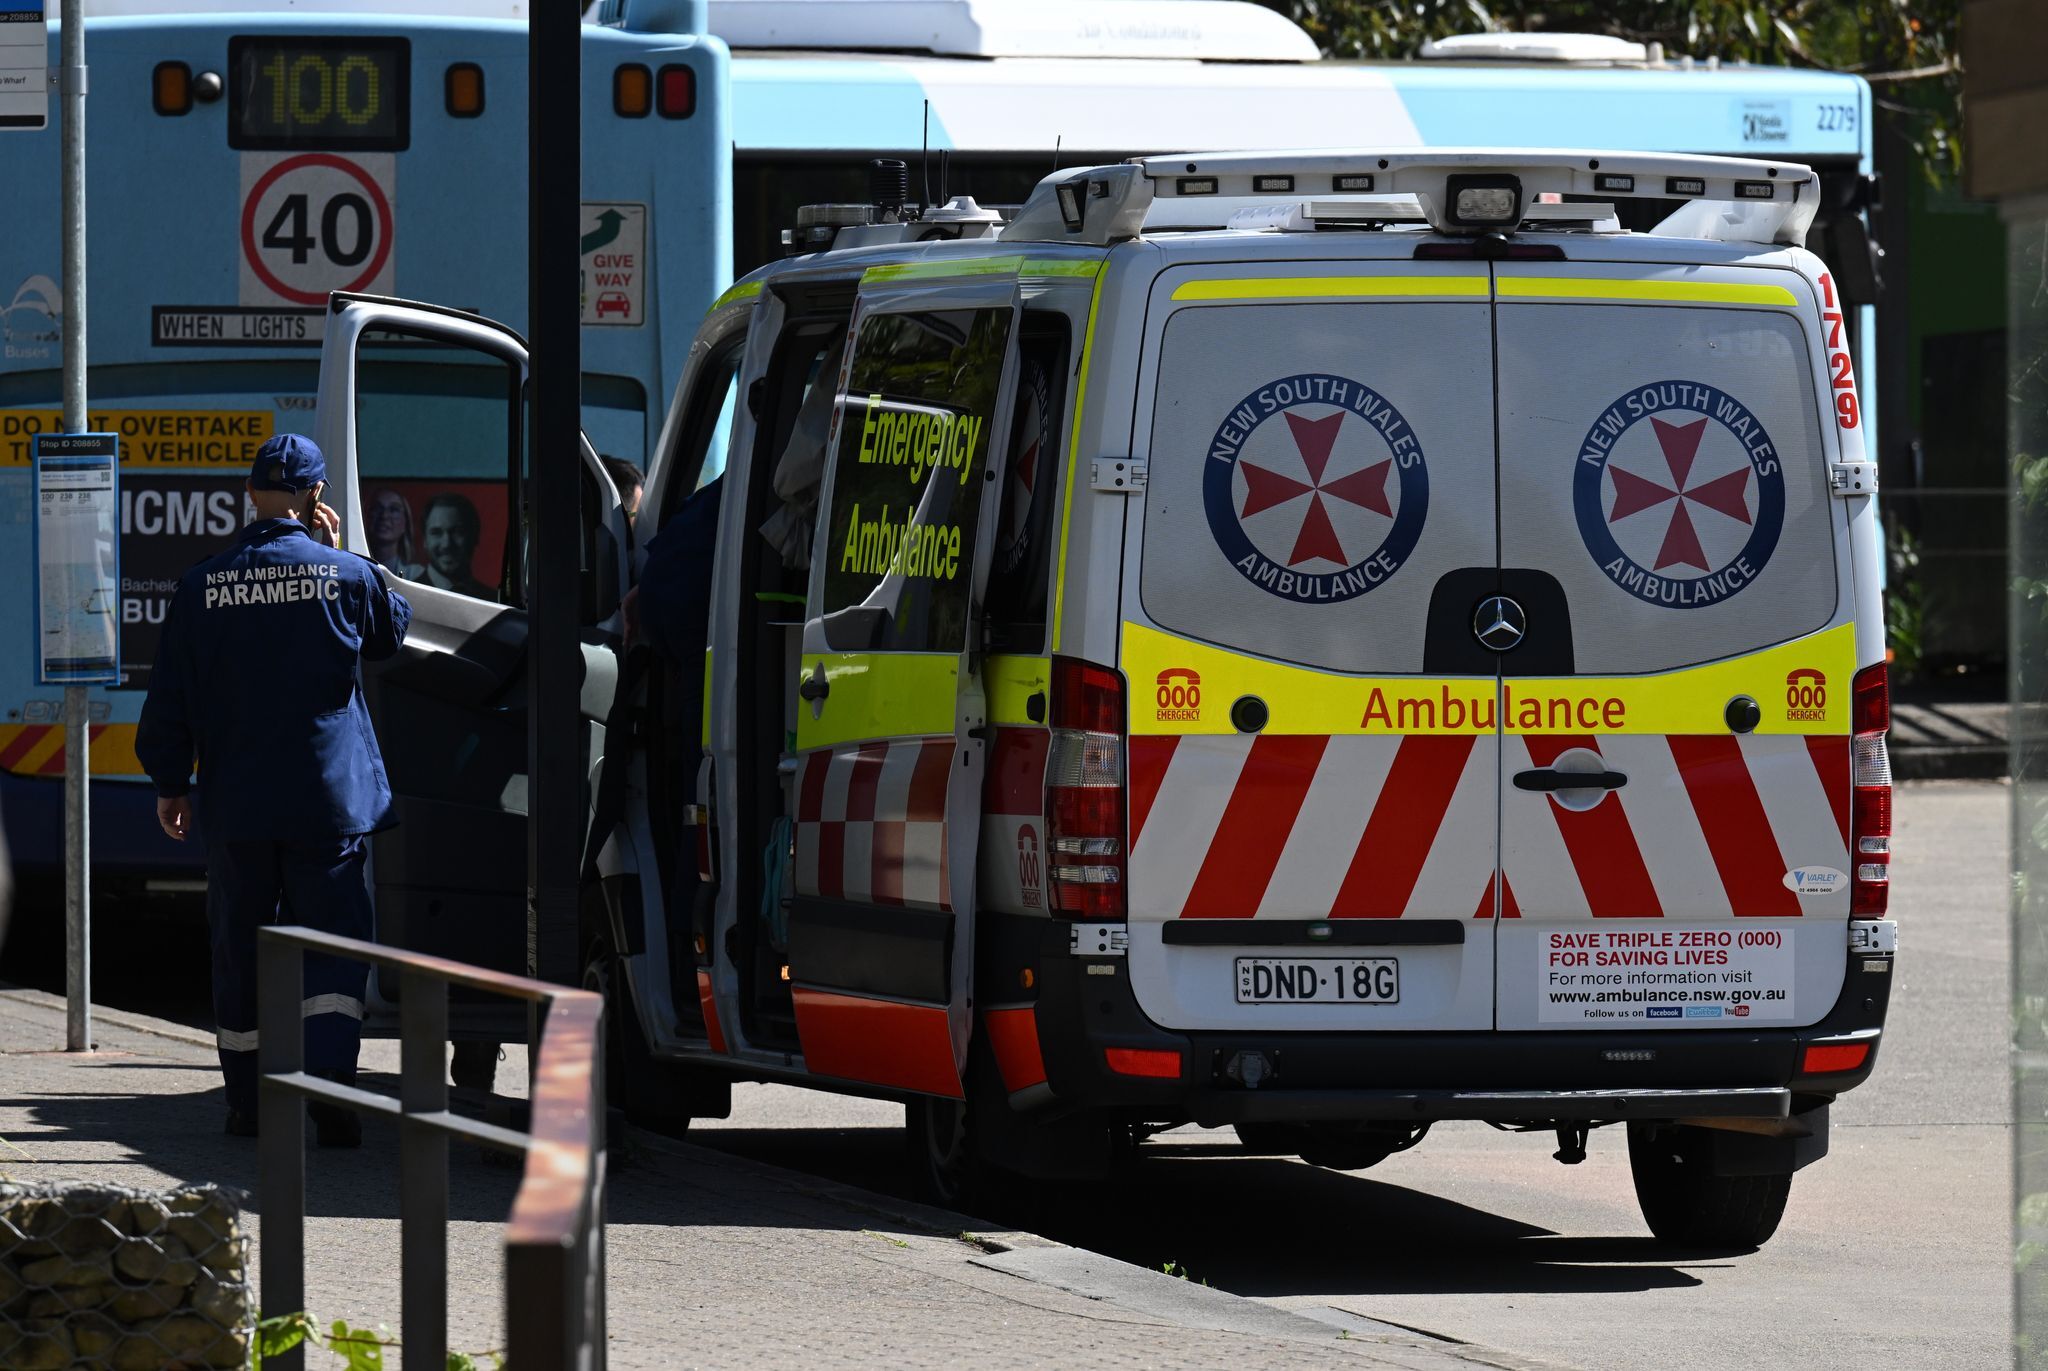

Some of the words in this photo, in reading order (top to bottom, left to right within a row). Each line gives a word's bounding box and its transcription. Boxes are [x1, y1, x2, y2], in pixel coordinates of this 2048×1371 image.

[3, 75, 26, 84] Wharf
[264, 55, 379, 125] 100
[1817, 104, 1855, 132] 2279
[263, 192, 374, 267] 40
[593, 254, 634, 268] GIVE
[595, 273, 632, 287] WAY
[162, 315, 224, 338] WHEN
[242, 315, 306, 338] LIGHTS
[1818, 273, 1858, 429] 1729
[4, 416, 42, 435] DO
[54, 416, 110, 434] NT
[120, 416, 263, 436] OVERTAKE
[1212, 403, 1258, 464] NEW
[1258, 378, 1348, 413] SOUTH
[1354, 389, 1421, 469] WALES
[1582, 407, 1626, 467] NEW
[1626, 384, 1710, 417] SOUTH
[1716, 396, 1778, 477] WALES
[40, 440, 59, 449] Stop
[61, 440, 70, 448] ID
[858, 394, 983, 485] Emergency
[142, 441, 256, 462] VEHICLE
[121, 490, 236, 536] ICMS
[841, 503, 961, 580] Ambulance
[206, 569, 239, 586] NSW
[244, 564, 339, 581] AMBULANCE
[1237, 550, 1398, 599] AMBULANCE
[1604, 556, 1756, 604] AMBULANCE
[205, 578, 340, 609] PARAMEDIC
[1156, 685, 1200, 709] 000
[1360, 685, 1626, 729] Ambulance
[1786, 685, 1826, 709] 000
[1156, 710, 1200, 720] EMERGENCY
[1786, 710, 1826, 720] EMERGENCY
[1019, 850, 1039, 888] 000
[1807, 873, 1837, 882] VARLEY
[1550, 933, 1600, 948] SAVE
[1606, 932, 1673, 948] TRIPLE
[1679, 932, 1732, 947] ZERO
[1737, 931, 1782, 949] (000)
[1550, 951, 1589, 967] FOR
[1595, 951, 1668, 966] SAVING
[1674, 950, 1728, 965] LIVES
[1549, 972, 1577, 985] For
[1581, 974, 1622, 985] more
[1627, 971, 1717, 984] information
[1722, 970, 1753, 983] visit
[1549, 989, 1786, 1004] www.ambulance.nsw.gov.au
[1584, 1009, 1615, 1018] Follow
[1618, 1010, 1629, 1018] us
[1632, 1010, 1644, 1018] on
[1650, 1009, 1679, 1017] facebook
[1687, 1007, 1720, 1017] twitter
